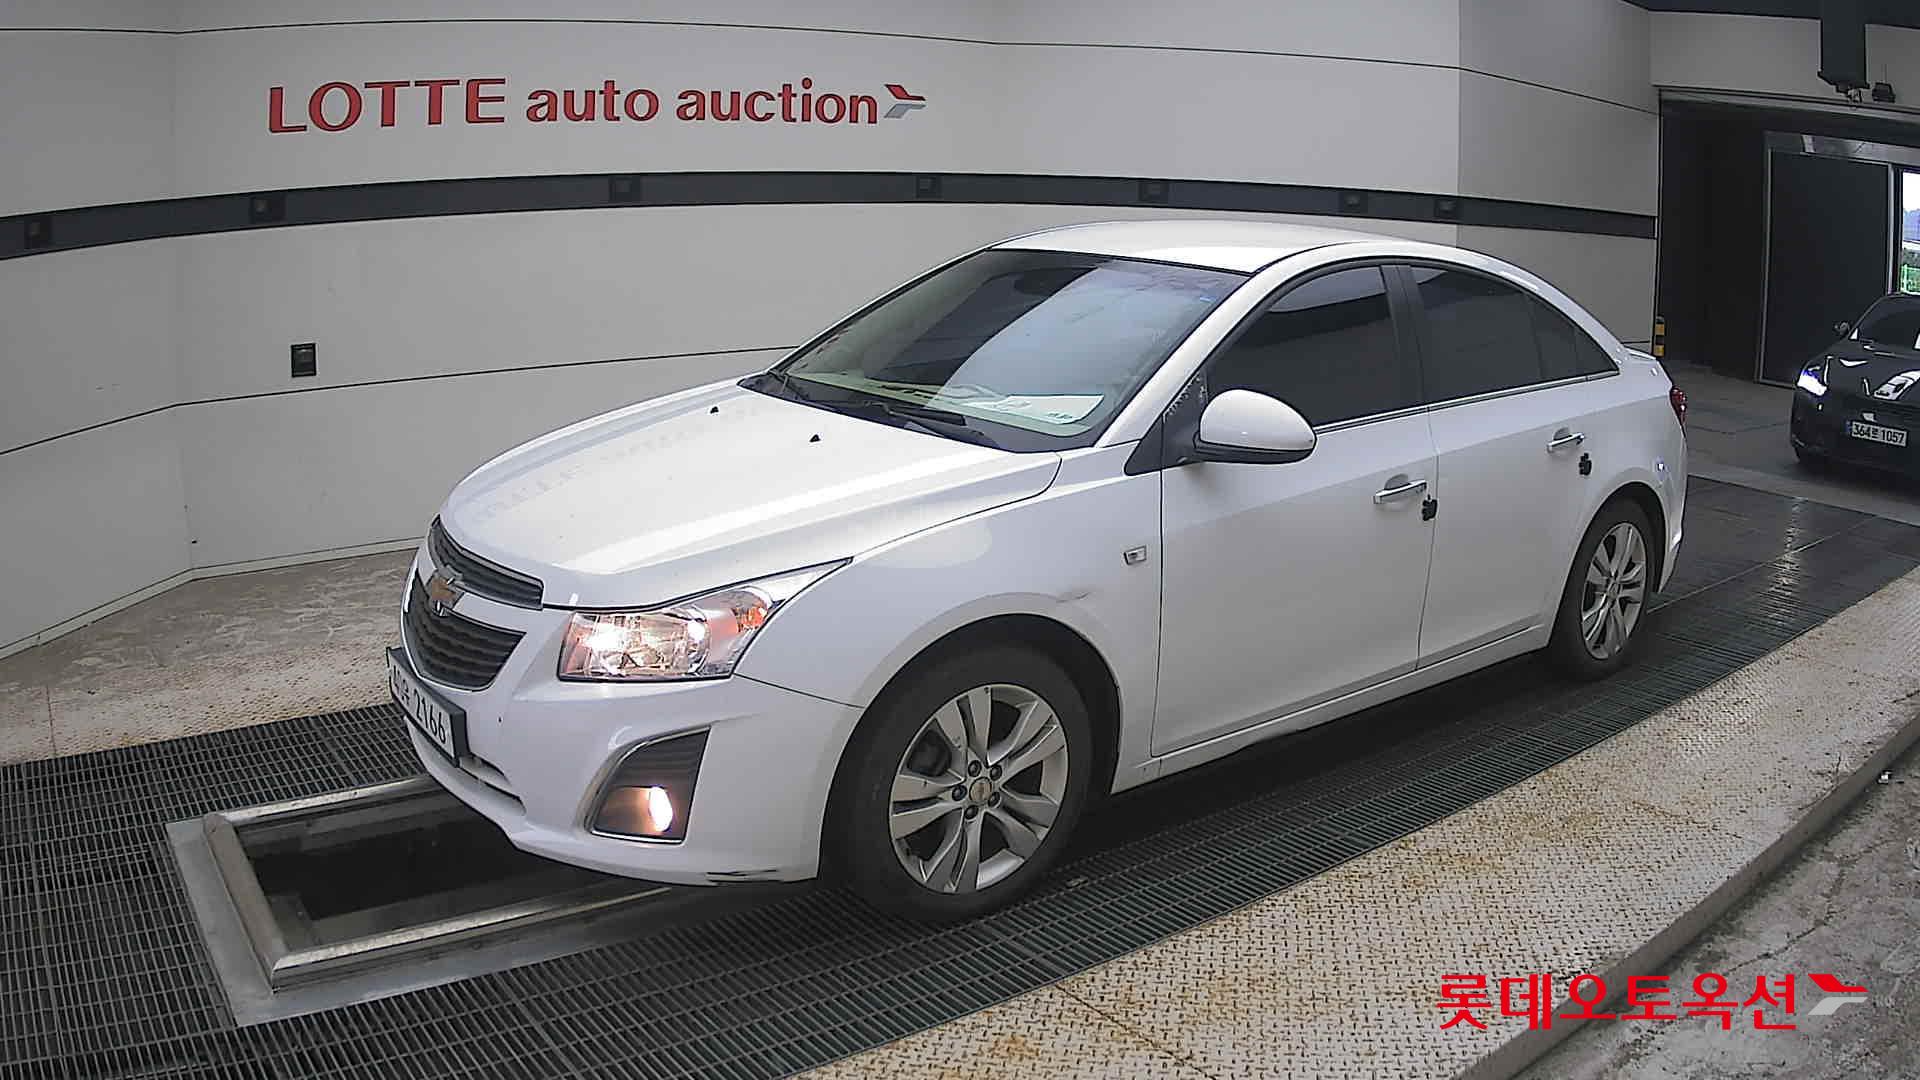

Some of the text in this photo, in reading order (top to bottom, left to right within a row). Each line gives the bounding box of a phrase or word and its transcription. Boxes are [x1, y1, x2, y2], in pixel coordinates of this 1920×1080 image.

[268, 77, 879, 134] LOTTE auto auction
[1881, 428, 1905, 444] 1057
[413, 687, 446, 745] 2166
